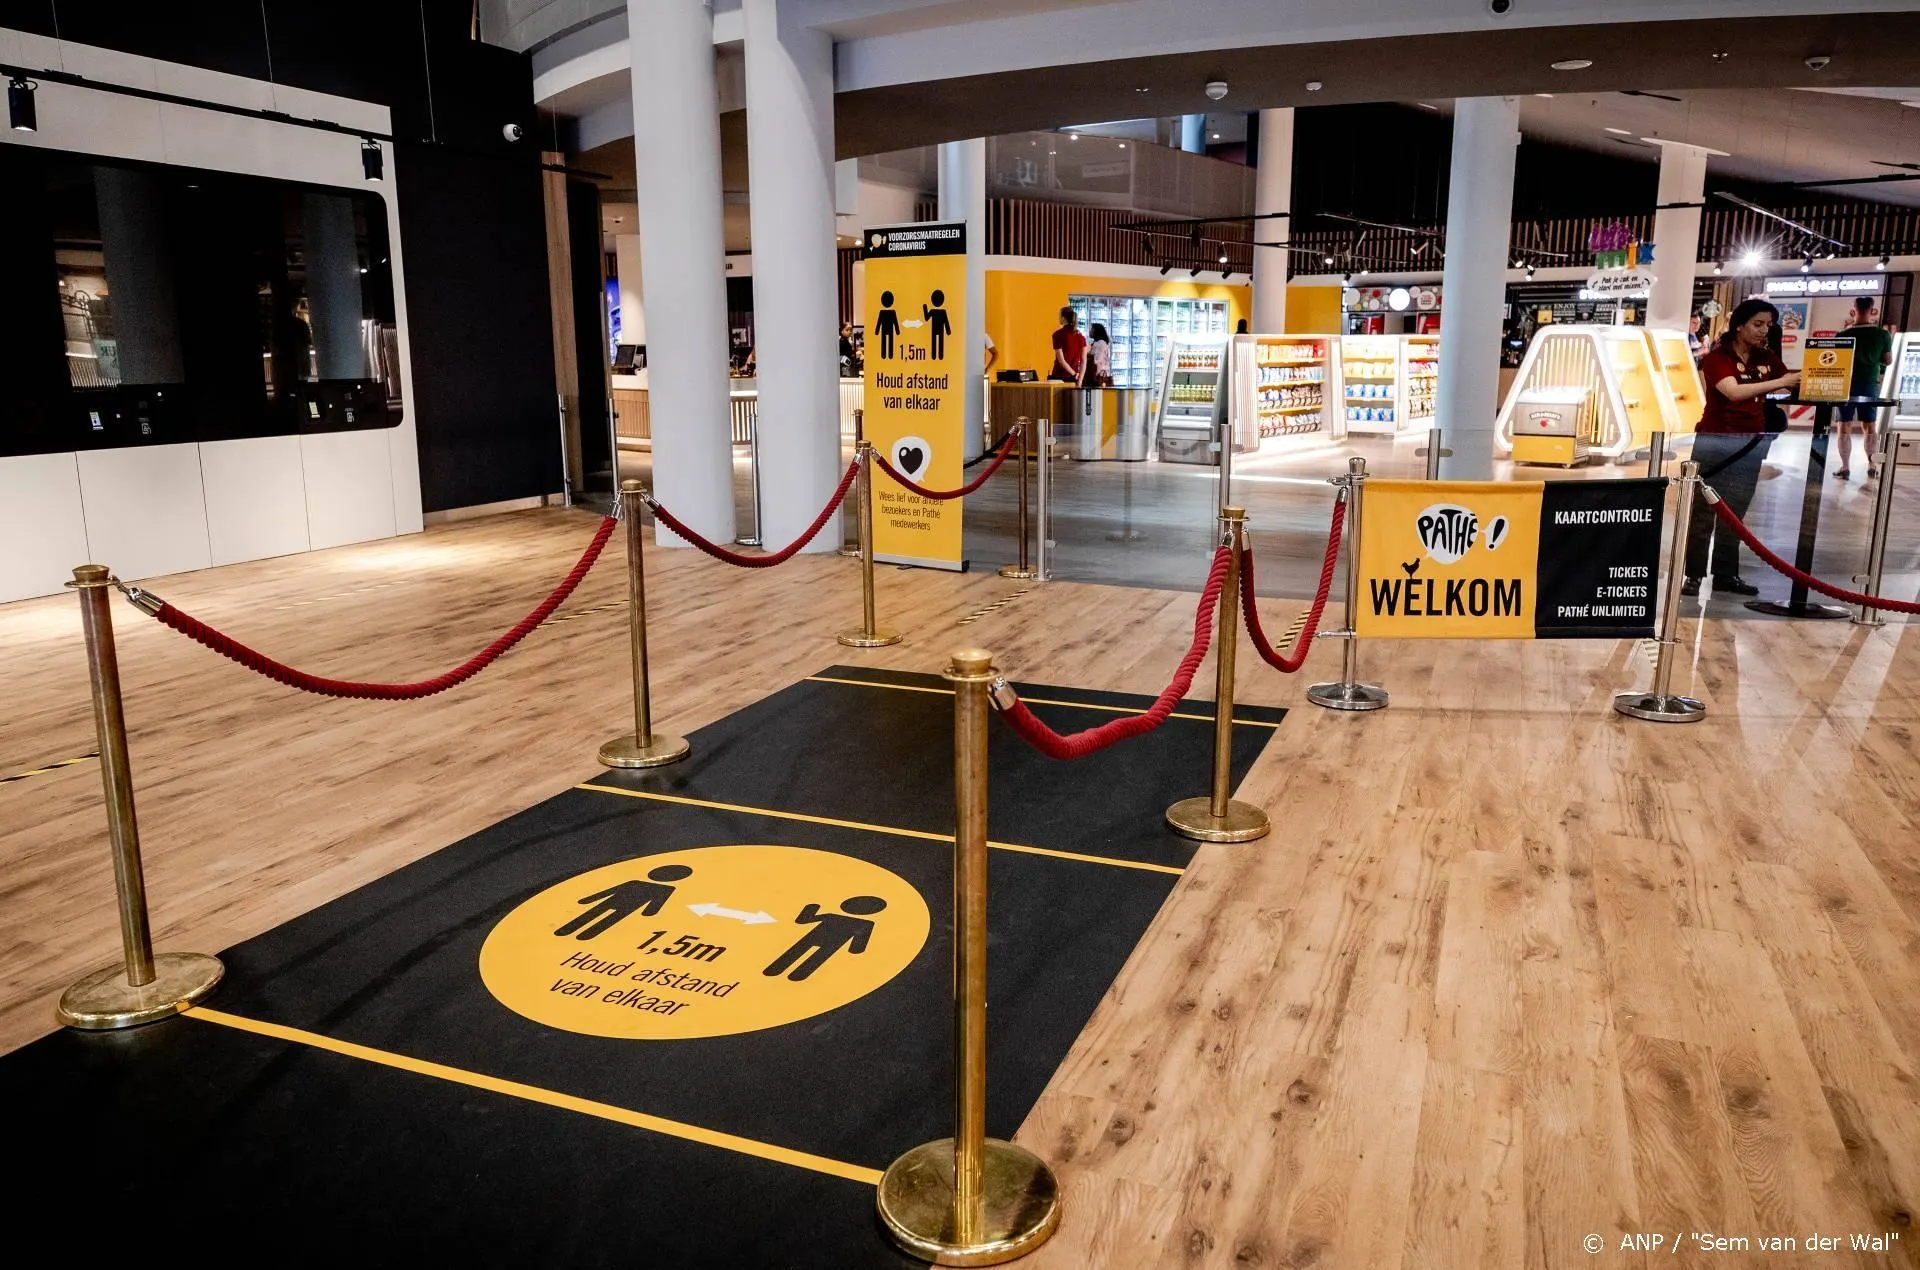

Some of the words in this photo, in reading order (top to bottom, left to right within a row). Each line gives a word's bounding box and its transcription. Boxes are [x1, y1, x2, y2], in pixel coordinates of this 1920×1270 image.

[888, 229, 960, 242] VOORZORGSMAATREGELEN
[888, 241, 926, 251] CORONAVIRUS
[899, 344, 926, 362] 1,5m
[876, 372, 903, 388] Houd
[906, 373, 948, 390] afstand
[883, 396, 902, 409] van
[905, 394, 940, 411] elkaar
[879, 491, 895, 502] Wees
[897, 492, 906, 503] lief
[908, 495, 921, 504] voor
[881, 504, 912, 516] bezoekers
[913, 508, 921, 516] en
[922, 507, 941, 519] Pathé
[1555, 509, 1653, 524] KAARTCONTROLE
[891, 519, 931, 531] medewerkers
[1608, 566, 1649, 578] TICKETS
[1370, 578, 1522, 617] WELKOM
[1596, 586, 1647, 598] E-TICKETS
[1557, 603, 1589, 618] PATHÉ
[1591, 605, 1646, 617] UNLIMITED
[636, 930, 727, 962] 1,5m
[560, 951, 636, 977] Houd
[631, 968, 740, 998] afstand
[550, 978, 601, 999] van
[602, 988, 690, 1016] elkaar
